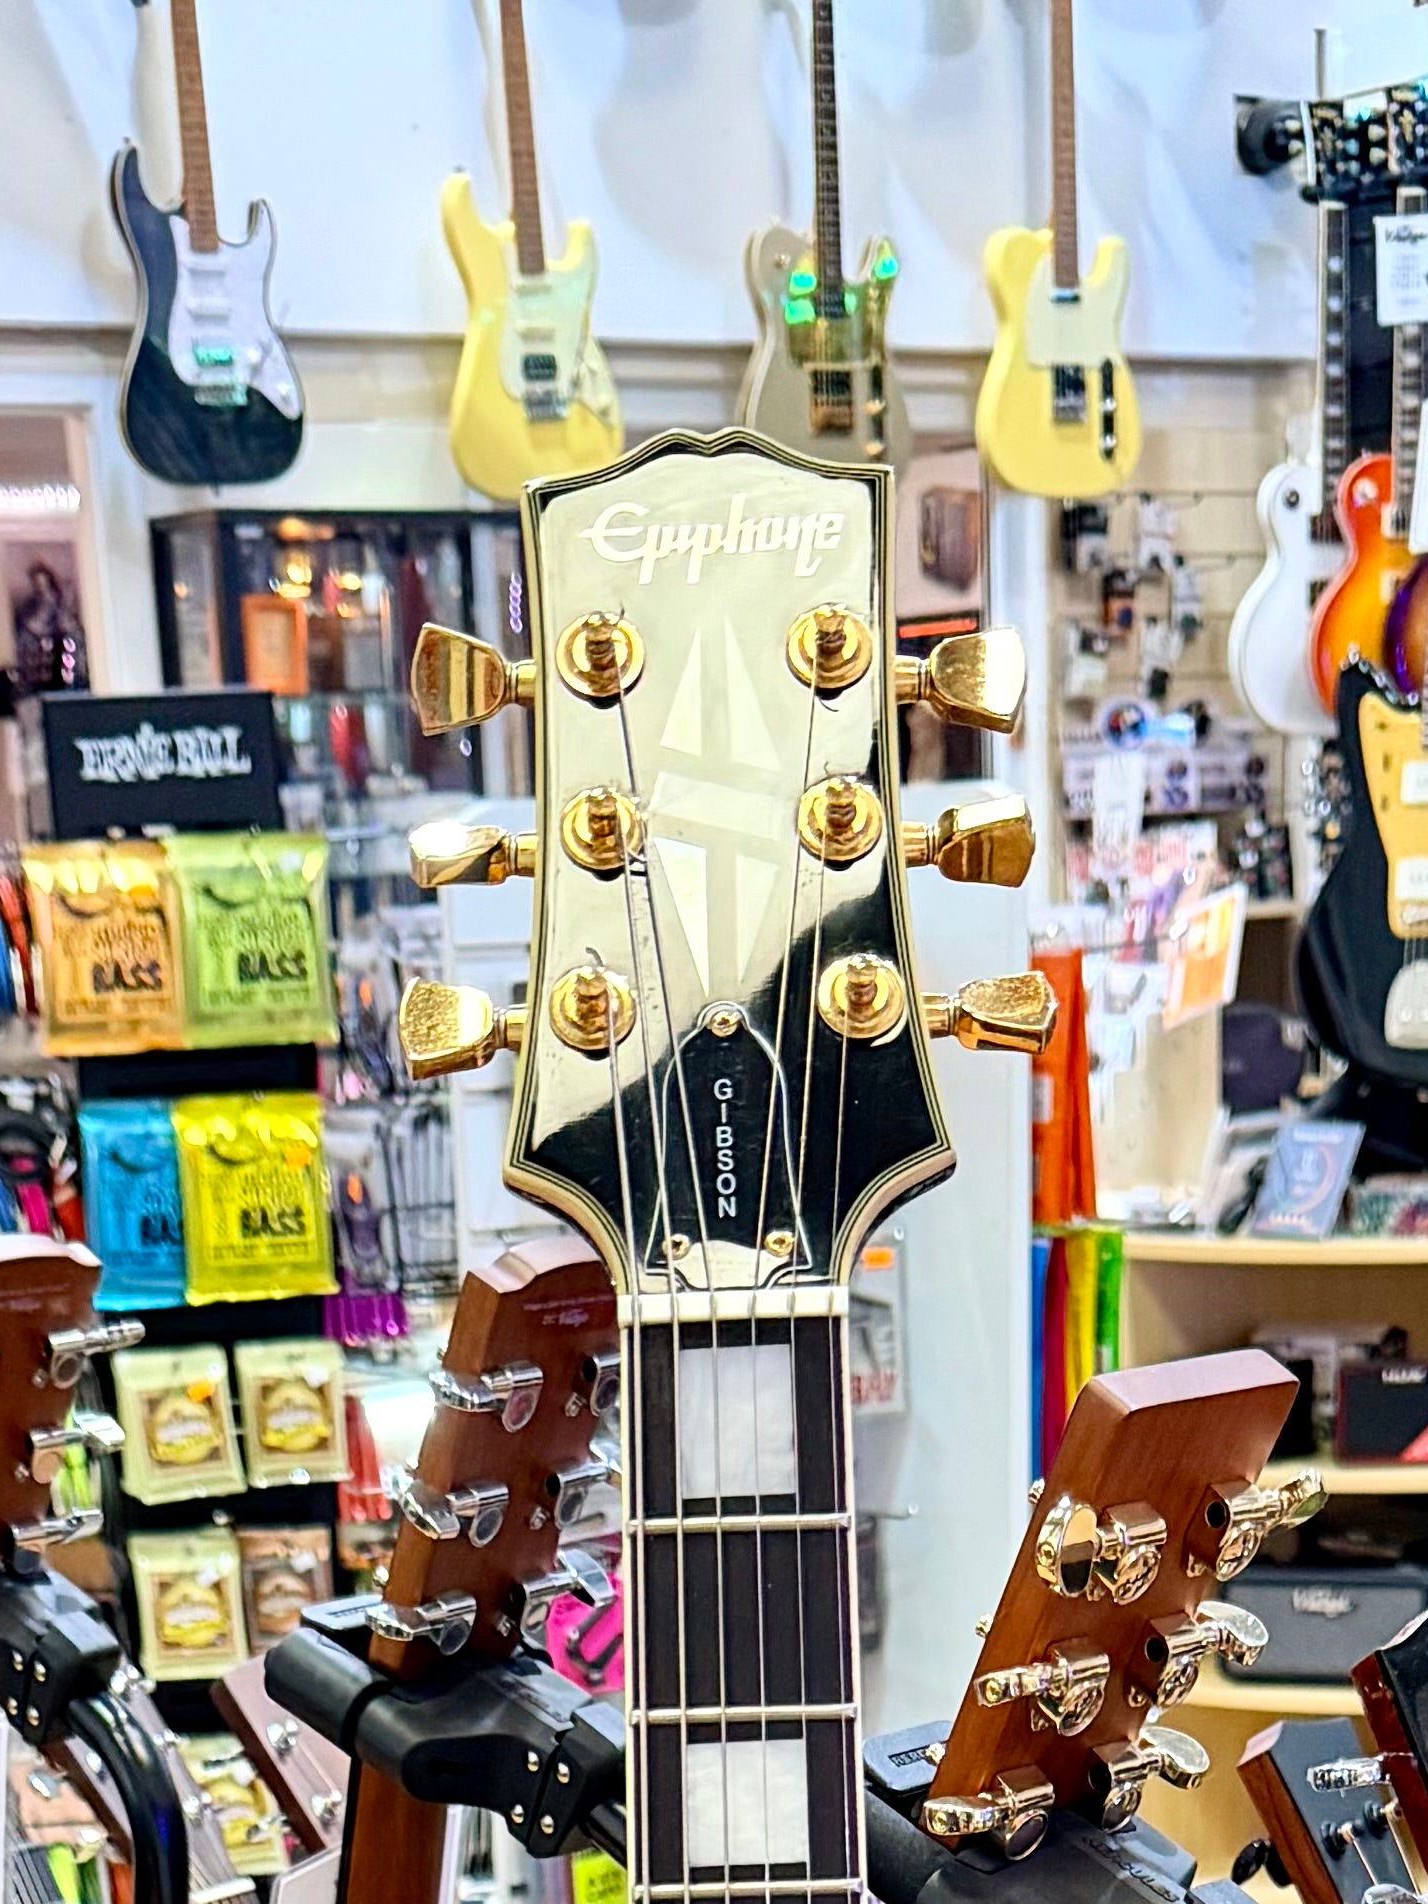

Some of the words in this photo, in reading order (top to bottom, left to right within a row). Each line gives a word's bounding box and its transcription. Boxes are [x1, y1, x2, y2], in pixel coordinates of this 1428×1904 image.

[580, 493, 844, 584] Epiphone
[91, 962, 163, 993] BASS
[712, 1078, 735, 1218] GIBSON
